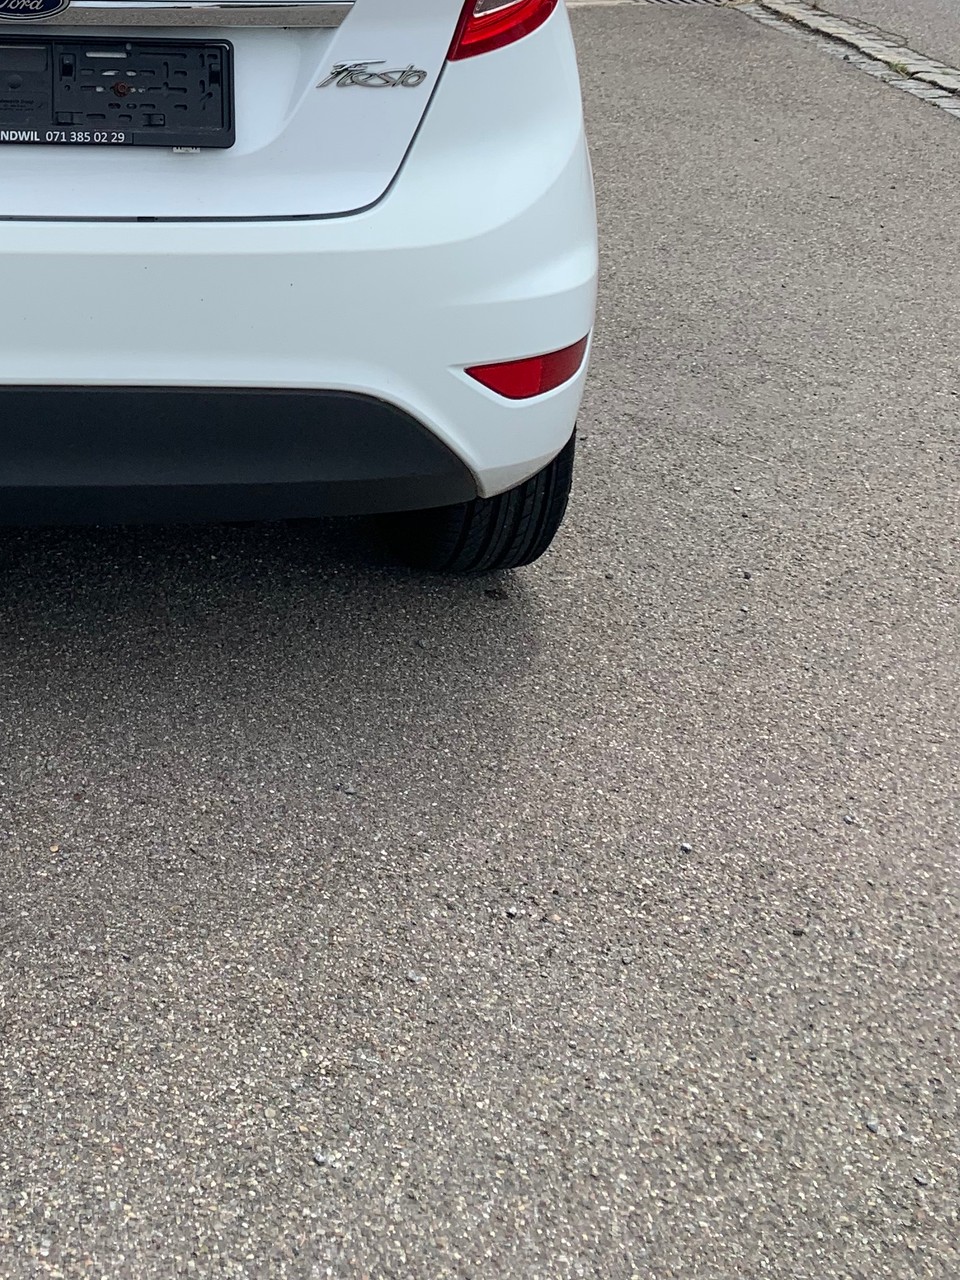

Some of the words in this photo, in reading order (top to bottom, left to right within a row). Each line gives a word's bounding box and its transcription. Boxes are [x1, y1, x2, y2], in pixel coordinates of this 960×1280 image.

[45, 131, 67, 142] 071
[70, 131, 91, 142] 385
[93, 132, 108, 143] 02
[110, 132, 125, 143] 29
